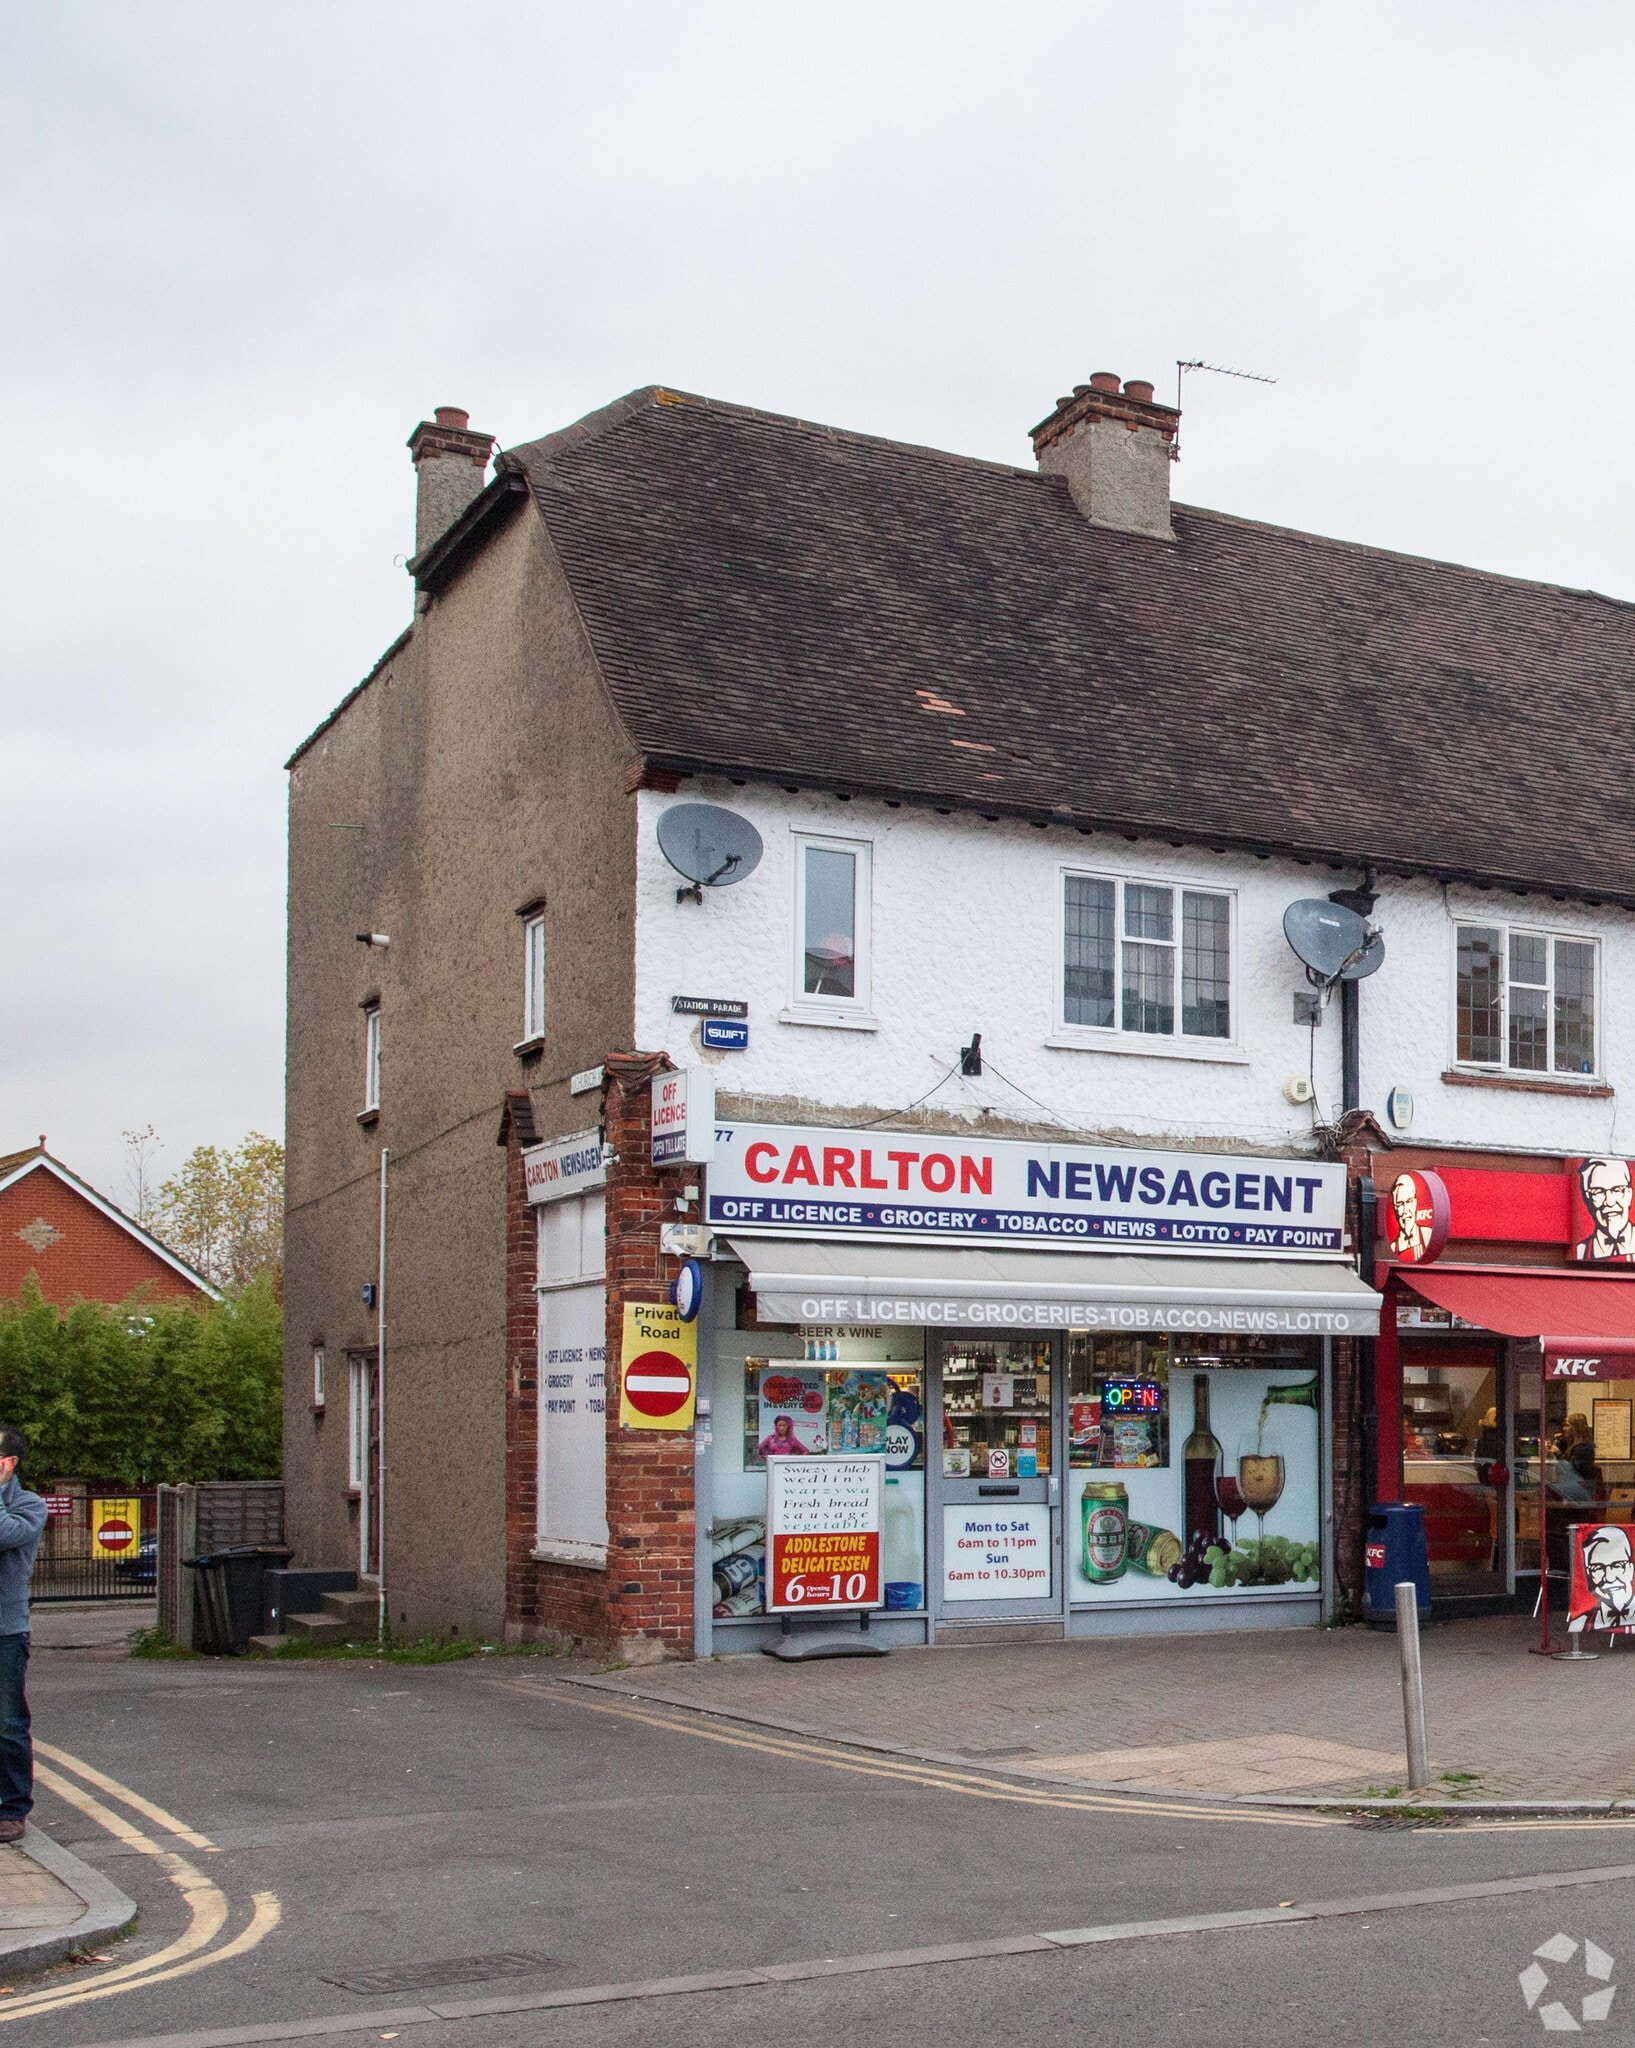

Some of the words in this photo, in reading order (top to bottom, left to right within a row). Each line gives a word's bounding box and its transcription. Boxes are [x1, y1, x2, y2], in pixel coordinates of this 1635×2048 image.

[678, 1001, 708, 1010] STATION
[714, 1003, 743, 1013] PARADE
[708, 1028, 746, 1040] SWIFT
[662, 1082, 677, 1102] OFF
[654, 1102, 686, 1126] LICENCE
[714, 1130, 734, 1142] 77
[653, 1140, 664, 1156] OPEN
[526, 1158, 559, 1188] CARLTON
[744, 1142, 993, 1195] CARLTON
[1027, 1159, 1323, 1214] NEWSAGENT
[1416, 1209, 1432, 1220] KFC
[722, 1201, 764, 1218] OFF
[771, 1204, 862, 1223] LICENCE
[880, 1208, 976, 1229] GROCERY
[996, 1214, 1088, 1234] TOBACCO
[1103, 1220, 1157, 1237] NEWS
[1172, 1224, 1230, 1241] LOTTO
[1245, 1228, 1278, 1244] PAY
[1282, 1231, 1334, 1246] POINT
[634, 1306, 681, 1320] Privat
[802, 1300, 848, 1319] OFF
[640, 1326, 680, 1340] Road
[798, 1326, 832, 1338] BEER
[836, 1327, 846, 1338] &
[849, 1328, 882, 1338] WINE
[548, 1350, 558, 1364] OFF
[560, 1348, 582, 1363] LICENCE
[1552, 1358, 1600, 1376] KFC
[548, 1374, 574, 1388] GROCERY
[589, 1373, 605, 1388] LOTT
[548, 1400, 558, 1413] PAY
[560, 1400, 576, 1413] POINT
[837, 1465, 870, 1473] chleb
[784, 1488, 870, 1496] warzywa
[784, 1498, 820, 1508] Fresh
[829, 1498, 869, 1508] bread
[784, 1512, 868, 1520] sausage
[784, 1520, 868, 1532] vegetable
[965, 1522, 992, 1532] Mon
[995, 1522, 1008, 1532] to
[1010, 1521, 1030, 1532] Sat
[784, 1536, 867, 1554] ADDLESTONE
[958, 1538, 984, 1548] 6am
[987, 1538, 999, 1548] to
[1004, 1537, 1036, 1549] 11pm
[986, 1554, 1008, 1564] Sun
[1367, 1548, 1384, 1558] KFC
[782, 1556, 870, 1574] DELICATESSEN
[948, 1570, 974, 1580] 6am
[978, 1570, 990, 1580] to
[994, 1568, 1046, 1580] 10.30pm
[785, 1574, 806, 1602] 6
[828, 1574, 866, 1600] 10
